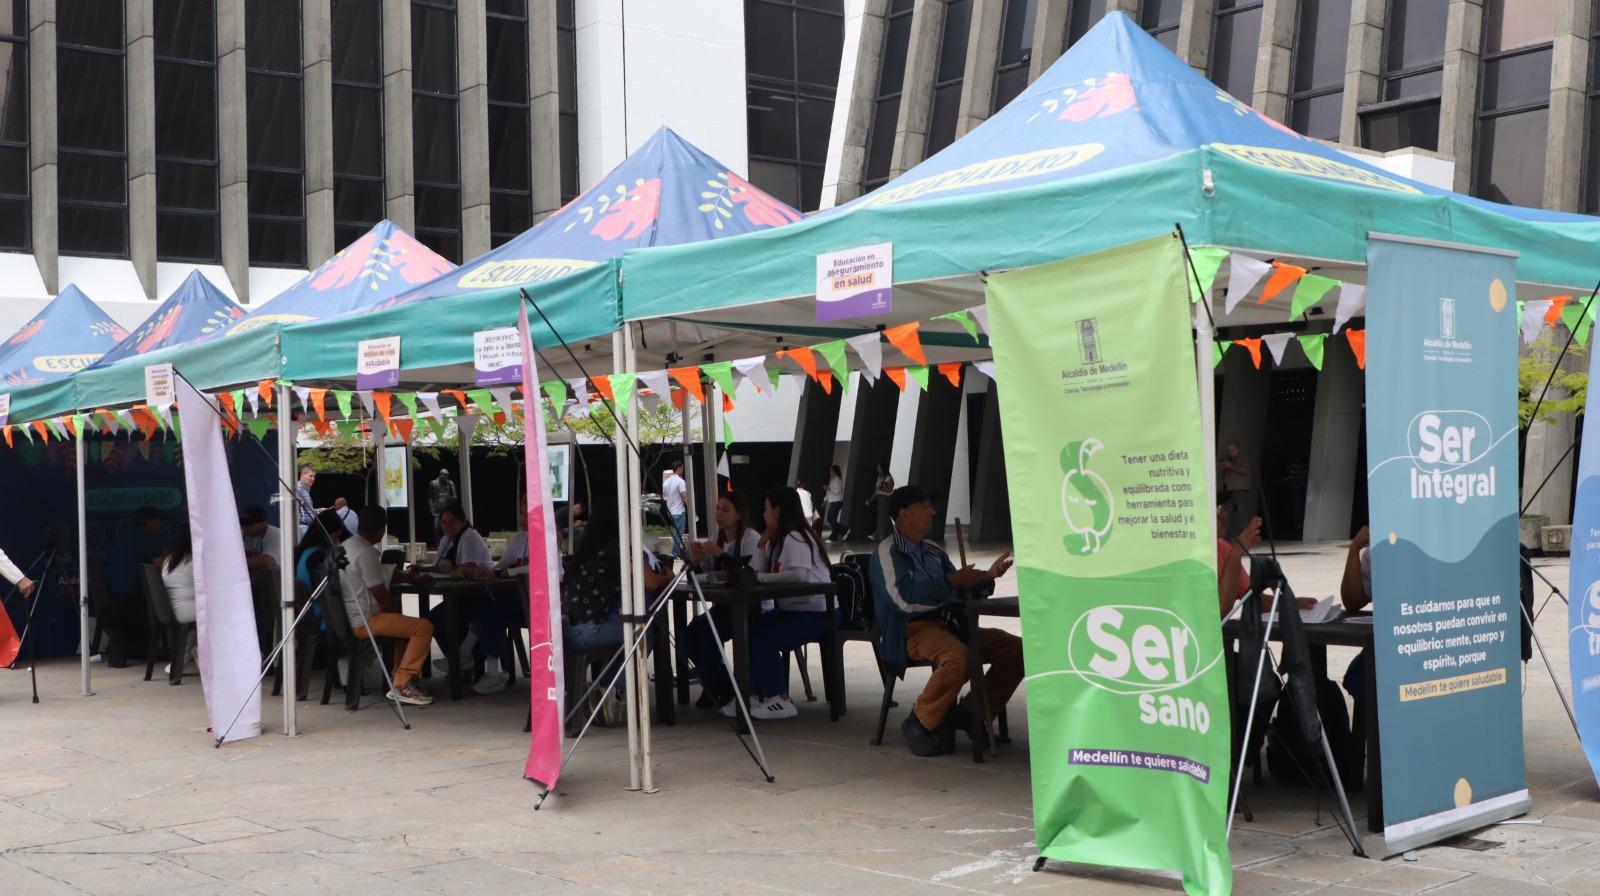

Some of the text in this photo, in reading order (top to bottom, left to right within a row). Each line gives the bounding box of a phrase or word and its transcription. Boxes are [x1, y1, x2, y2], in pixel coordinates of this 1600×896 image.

[827, 260, 884, 277] aseguramiento
[834, 255, 866, 266] Educación
[834, 274, 872, 288] en salud
[1444, 340, 1452, 348] de
[366, 358, 390, 367] saludable
[1090, 366, 1098, 376] de
[1418, 414, 1476, 464] Ser
[1122, 450, 1188, 465] Tener una dieta
[1149, 466, 1190, 478] nutritiva y
[1123, 483, 1192, 496] equilibrada como
[1410, 466, 1496, 504] Integral
[1126, 498, 1194, 510] herramienta para
[1118, 514, 1148, 526] mejorar
[1151, 514, 1158, 524] la
[1160, 513, 1182, 524] salud
[1184, 516, 1189, 525] y
[1151, 529, 1196, 540] bienestar es
[1401, 595, 1500, 616] Es cuidarnos para que en
[1394, 611, 1507, 636] nosotros puedan convivir en
[1086, 606, 1188, 683] Ser
[1398, 630, 1505, 656] equilibrio: mente, cuerpo y
[1423, 650, 1486, 671] espíritu, porque
[1405, 672, 1502, 698] Medellín te quiere saludable
[1138, 693, 1210, 734] sano
[1073, 750, 1206, 780] Medellín te quiere saludable
